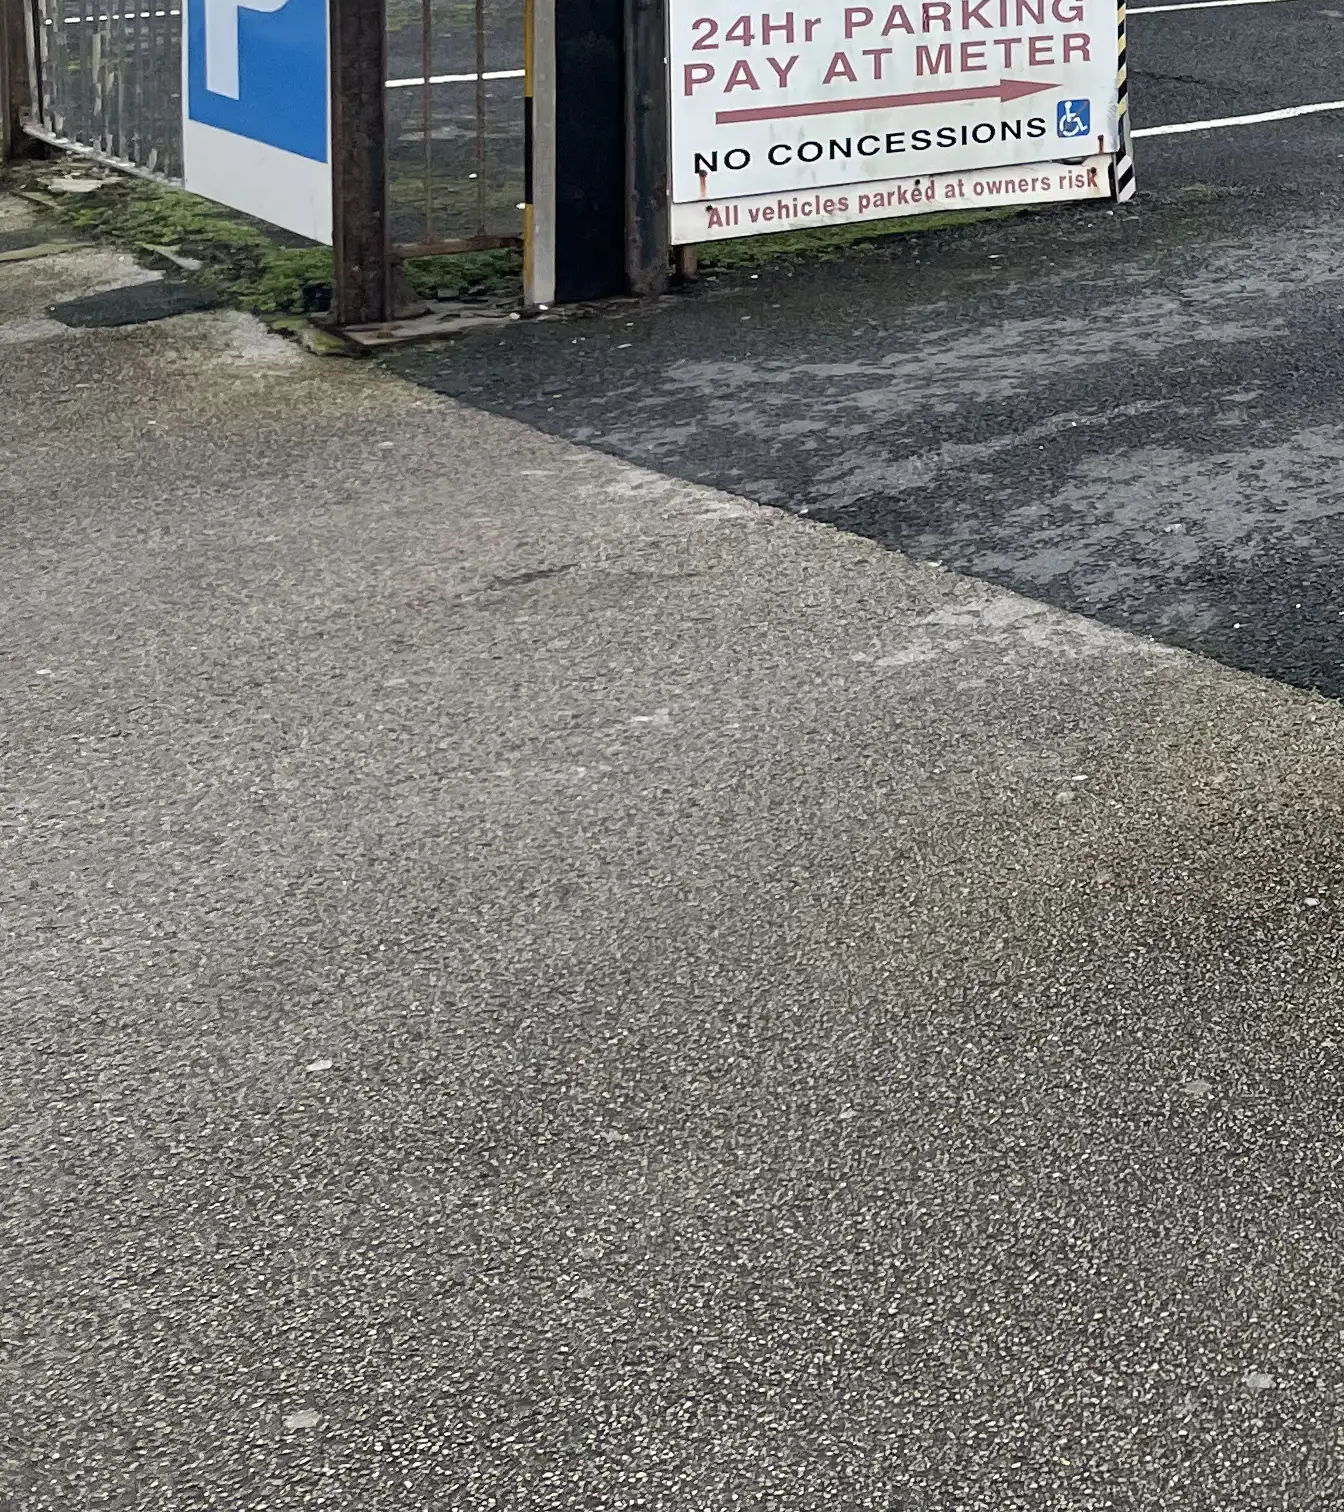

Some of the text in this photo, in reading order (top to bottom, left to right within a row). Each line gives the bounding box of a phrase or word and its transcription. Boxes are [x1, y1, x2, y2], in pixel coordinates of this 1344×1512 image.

[691, 11, 821, 51] 24Hr
[684, 33, 1091, 96] PAY AT METER
[694, 117, 1046, 175] NO CONCESSIONS
[707, 169, 1098, 229] All vehicles parked at owners risk
